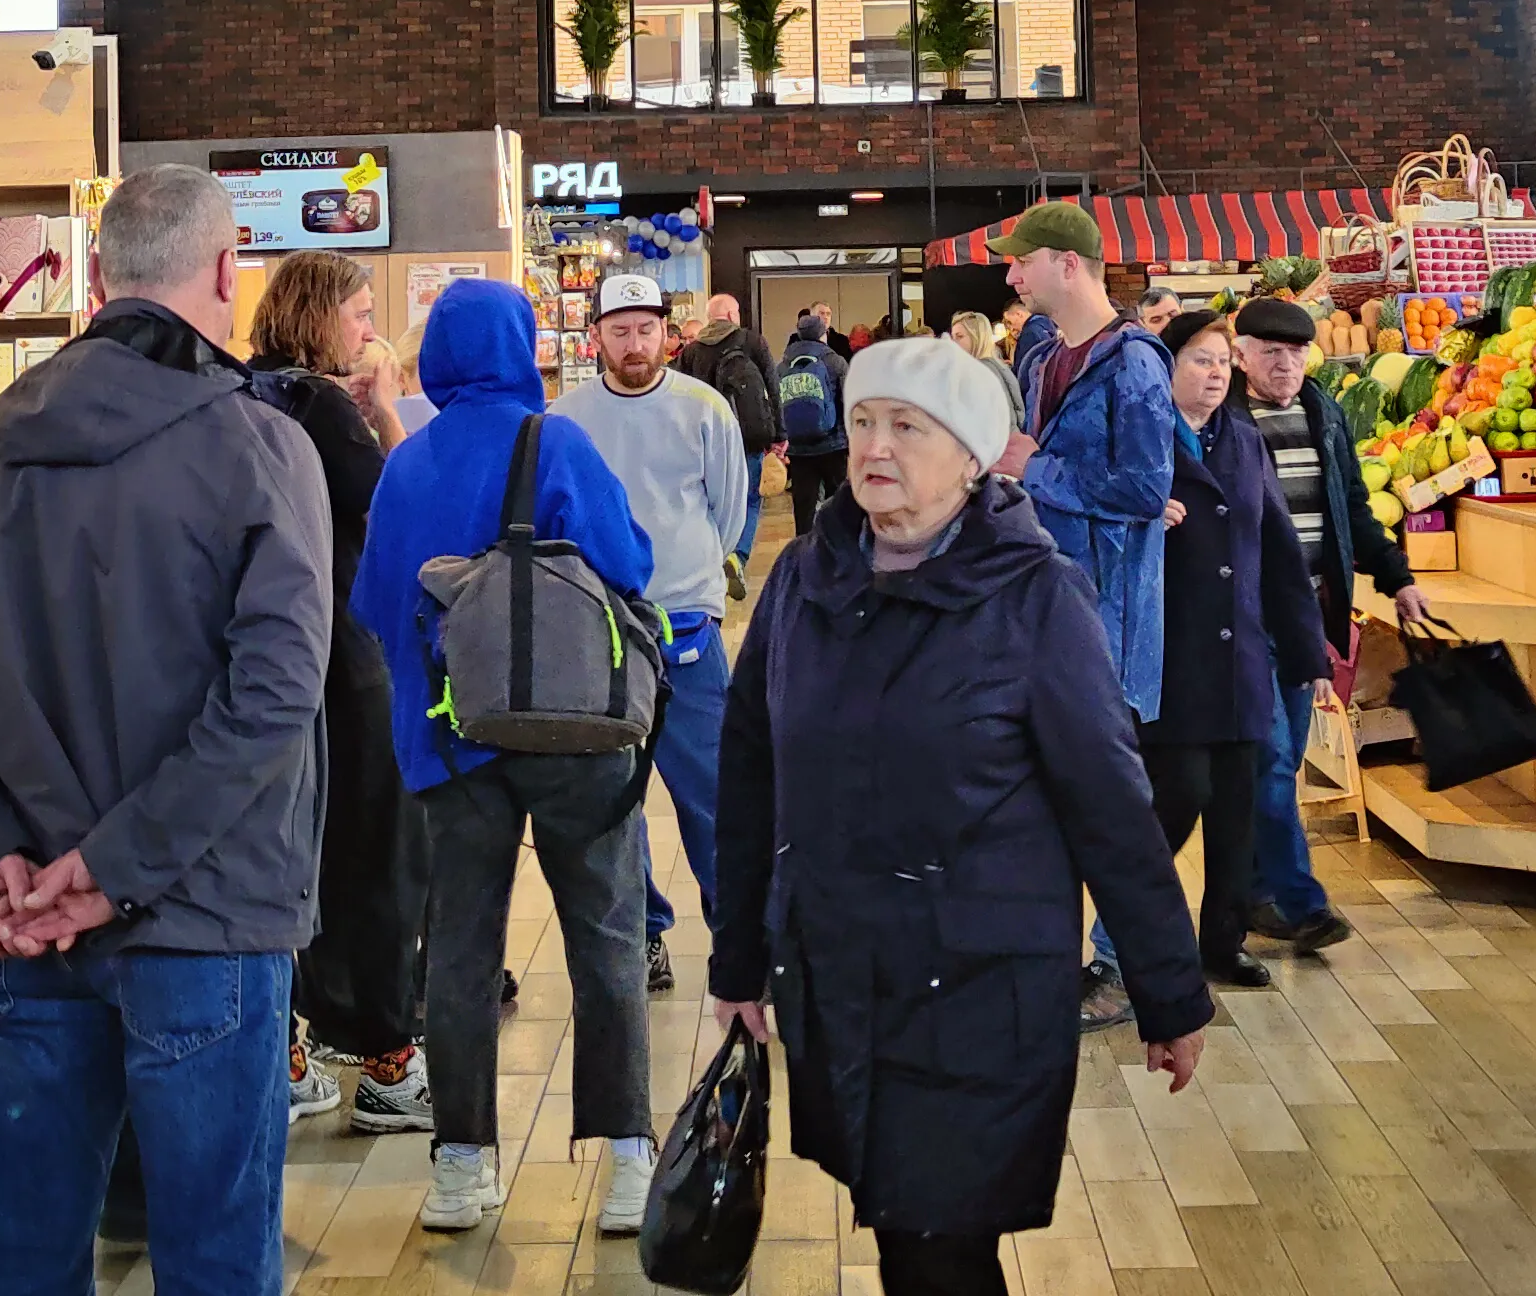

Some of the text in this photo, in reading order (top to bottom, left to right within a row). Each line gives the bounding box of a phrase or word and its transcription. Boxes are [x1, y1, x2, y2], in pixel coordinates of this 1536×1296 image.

[260, 151, 338, 168] СКИДКИ
[223, 180, 253, 189] АШТЕТ
[532, 161, 623, 199] РЯД
[230, 188, 282, 199] БЛЁВСКИЙ
